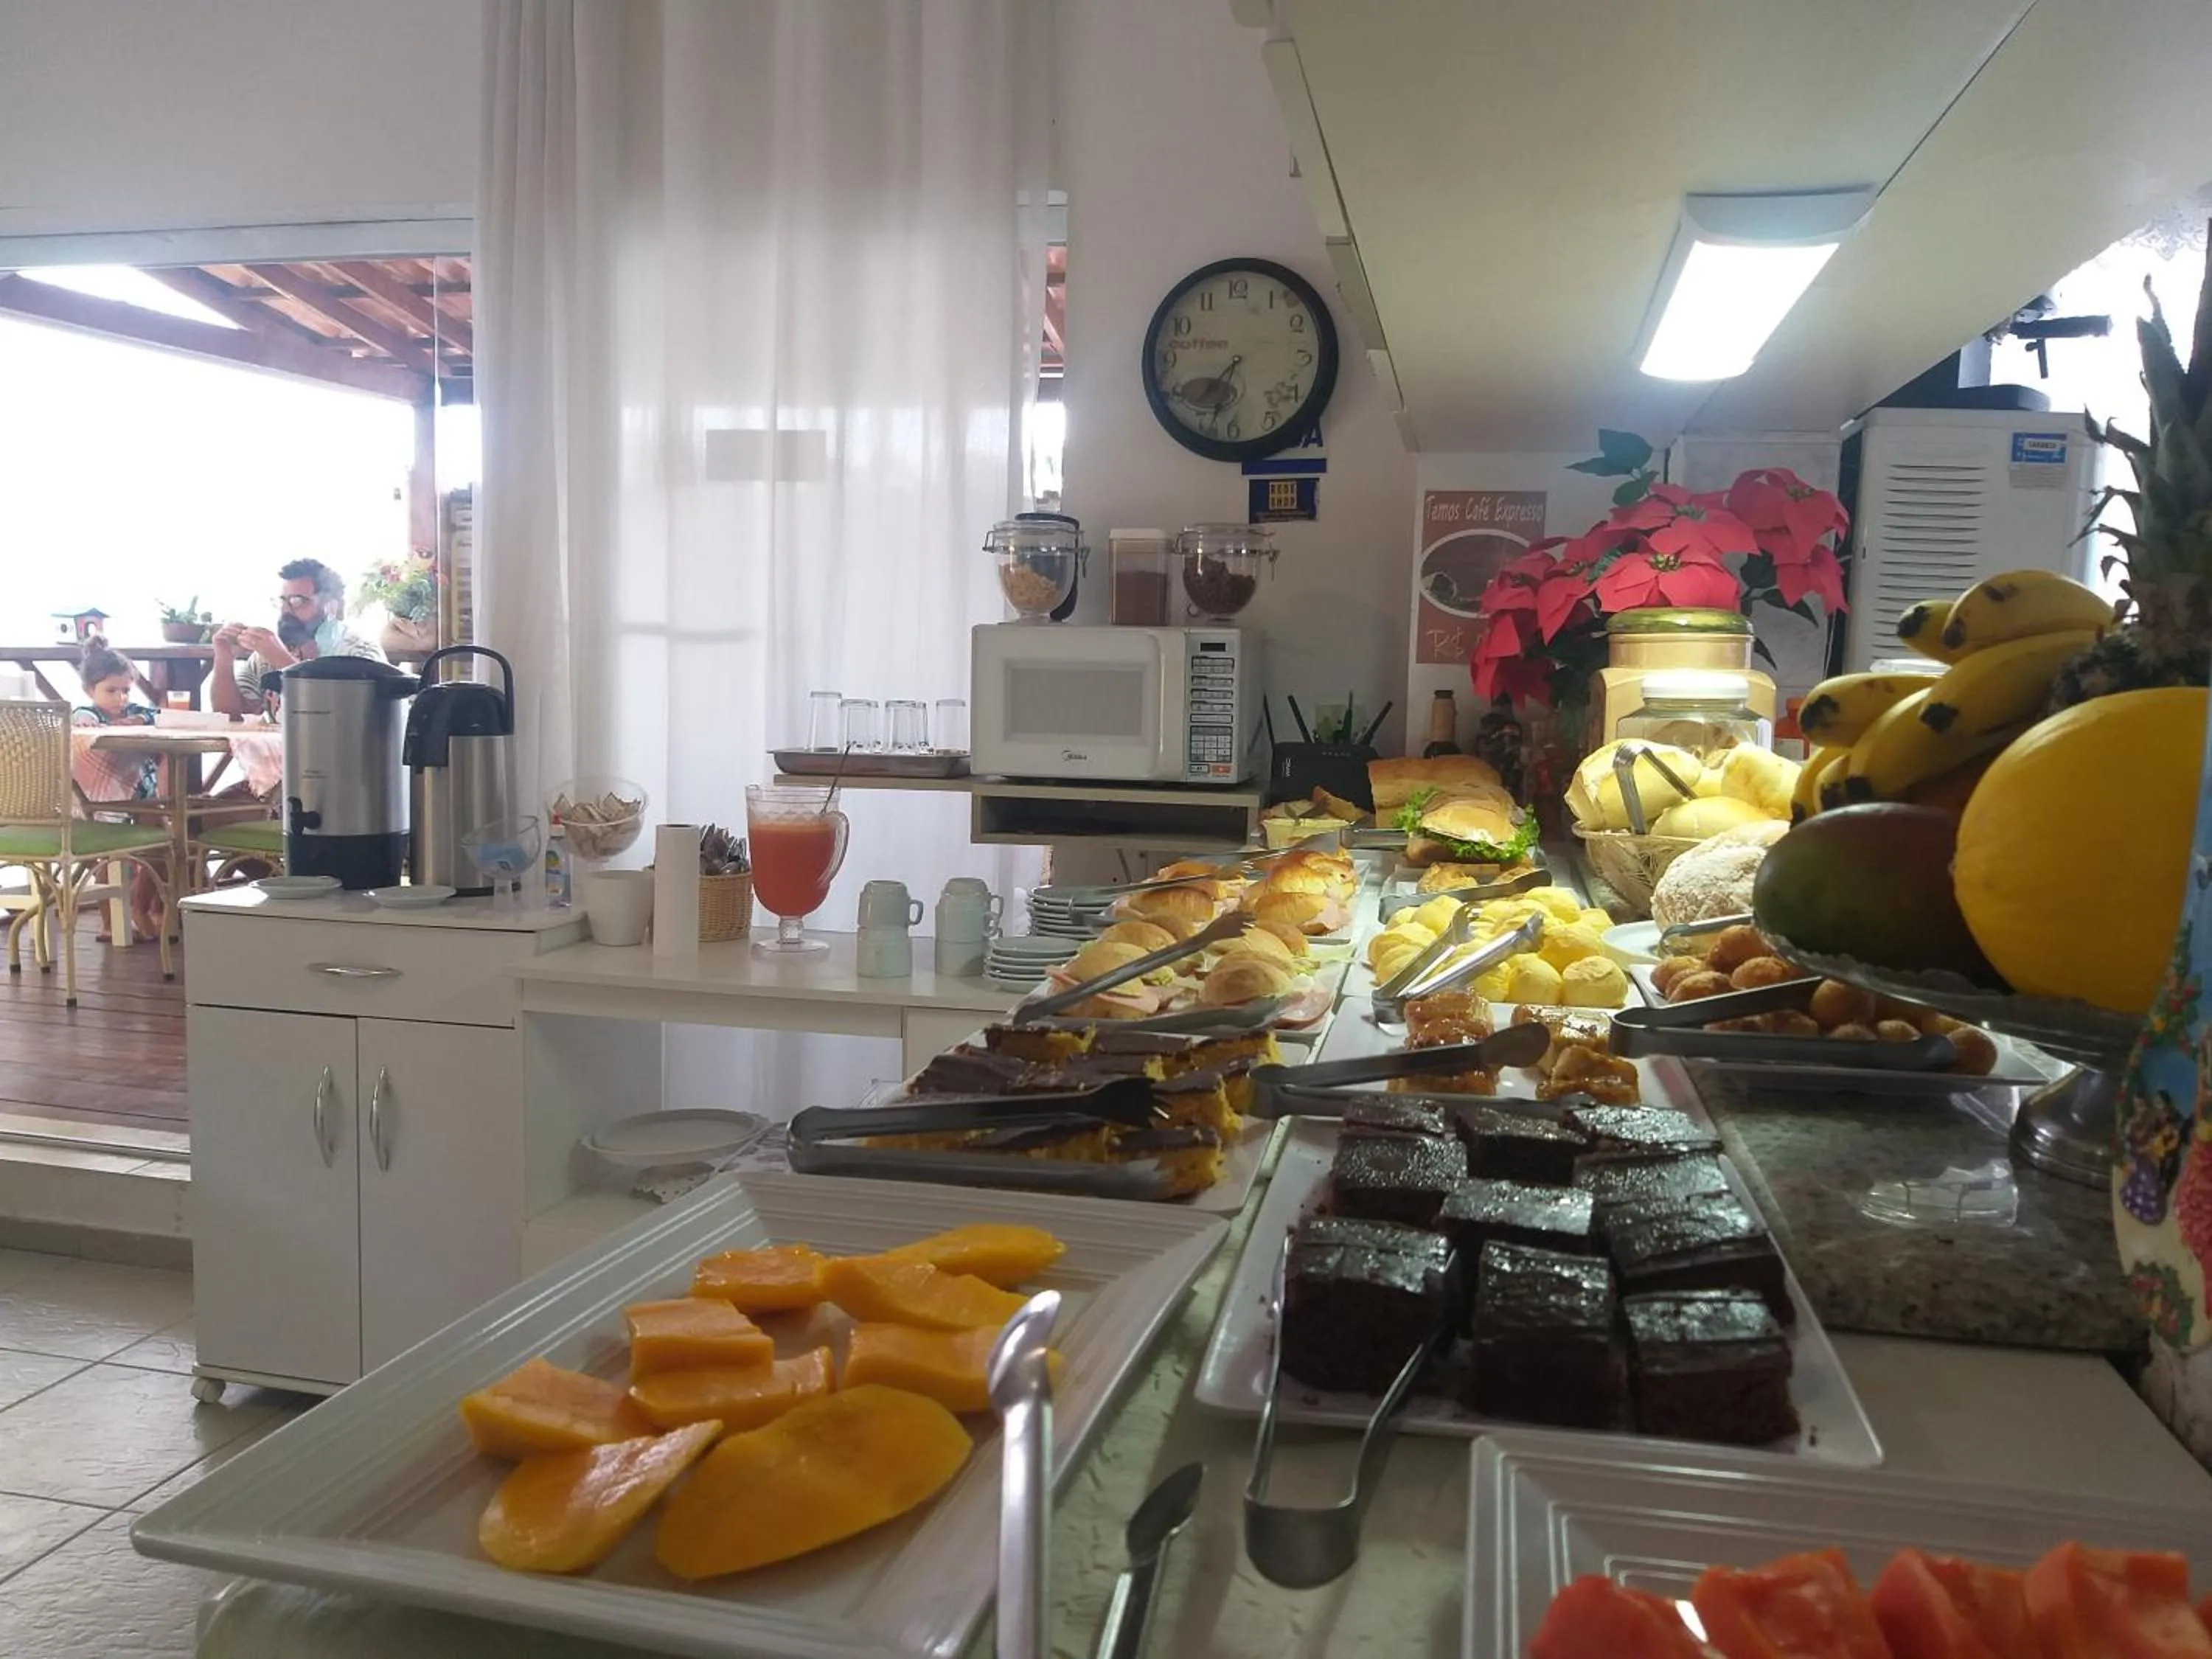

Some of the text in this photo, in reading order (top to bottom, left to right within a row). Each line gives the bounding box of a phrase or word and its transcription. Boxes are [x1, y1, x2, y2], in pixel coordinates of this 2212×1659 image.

[1228, 280, 1248, 299] 12
[1200, 292, 1213, 311] 11
[1268, 290, 1274, 309] 1
[1174, 316, 1192, 336] 10
[1465, 495, 1492, 521] Café
[1495, 496, 1544, 529] Expresso
